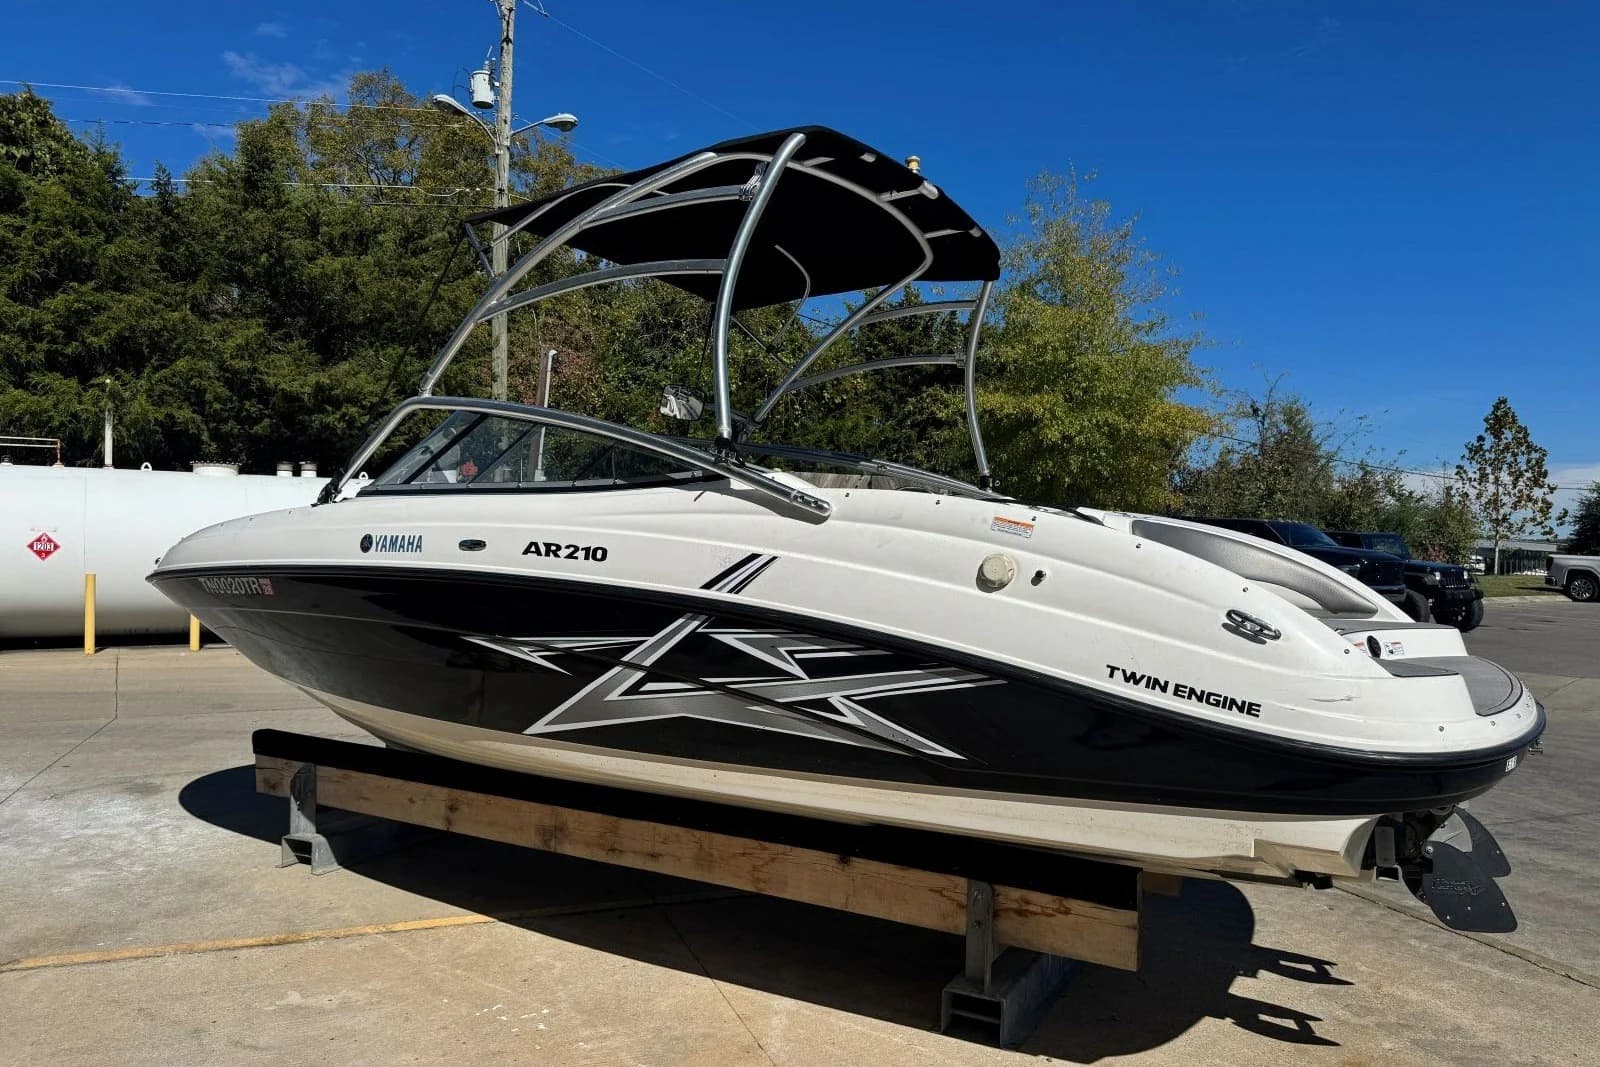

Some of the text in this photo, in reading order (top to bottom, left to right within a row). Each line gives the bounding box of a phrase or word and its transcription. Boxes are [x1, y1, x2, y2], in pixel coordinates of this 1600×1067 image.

[34, 542, 54, 551] 1203
[375, 535, 423, 553] YAMAHA
[522, 541, 608, 562] AR210
[1106, 664, 1262, 718] TWIN ENGINE
